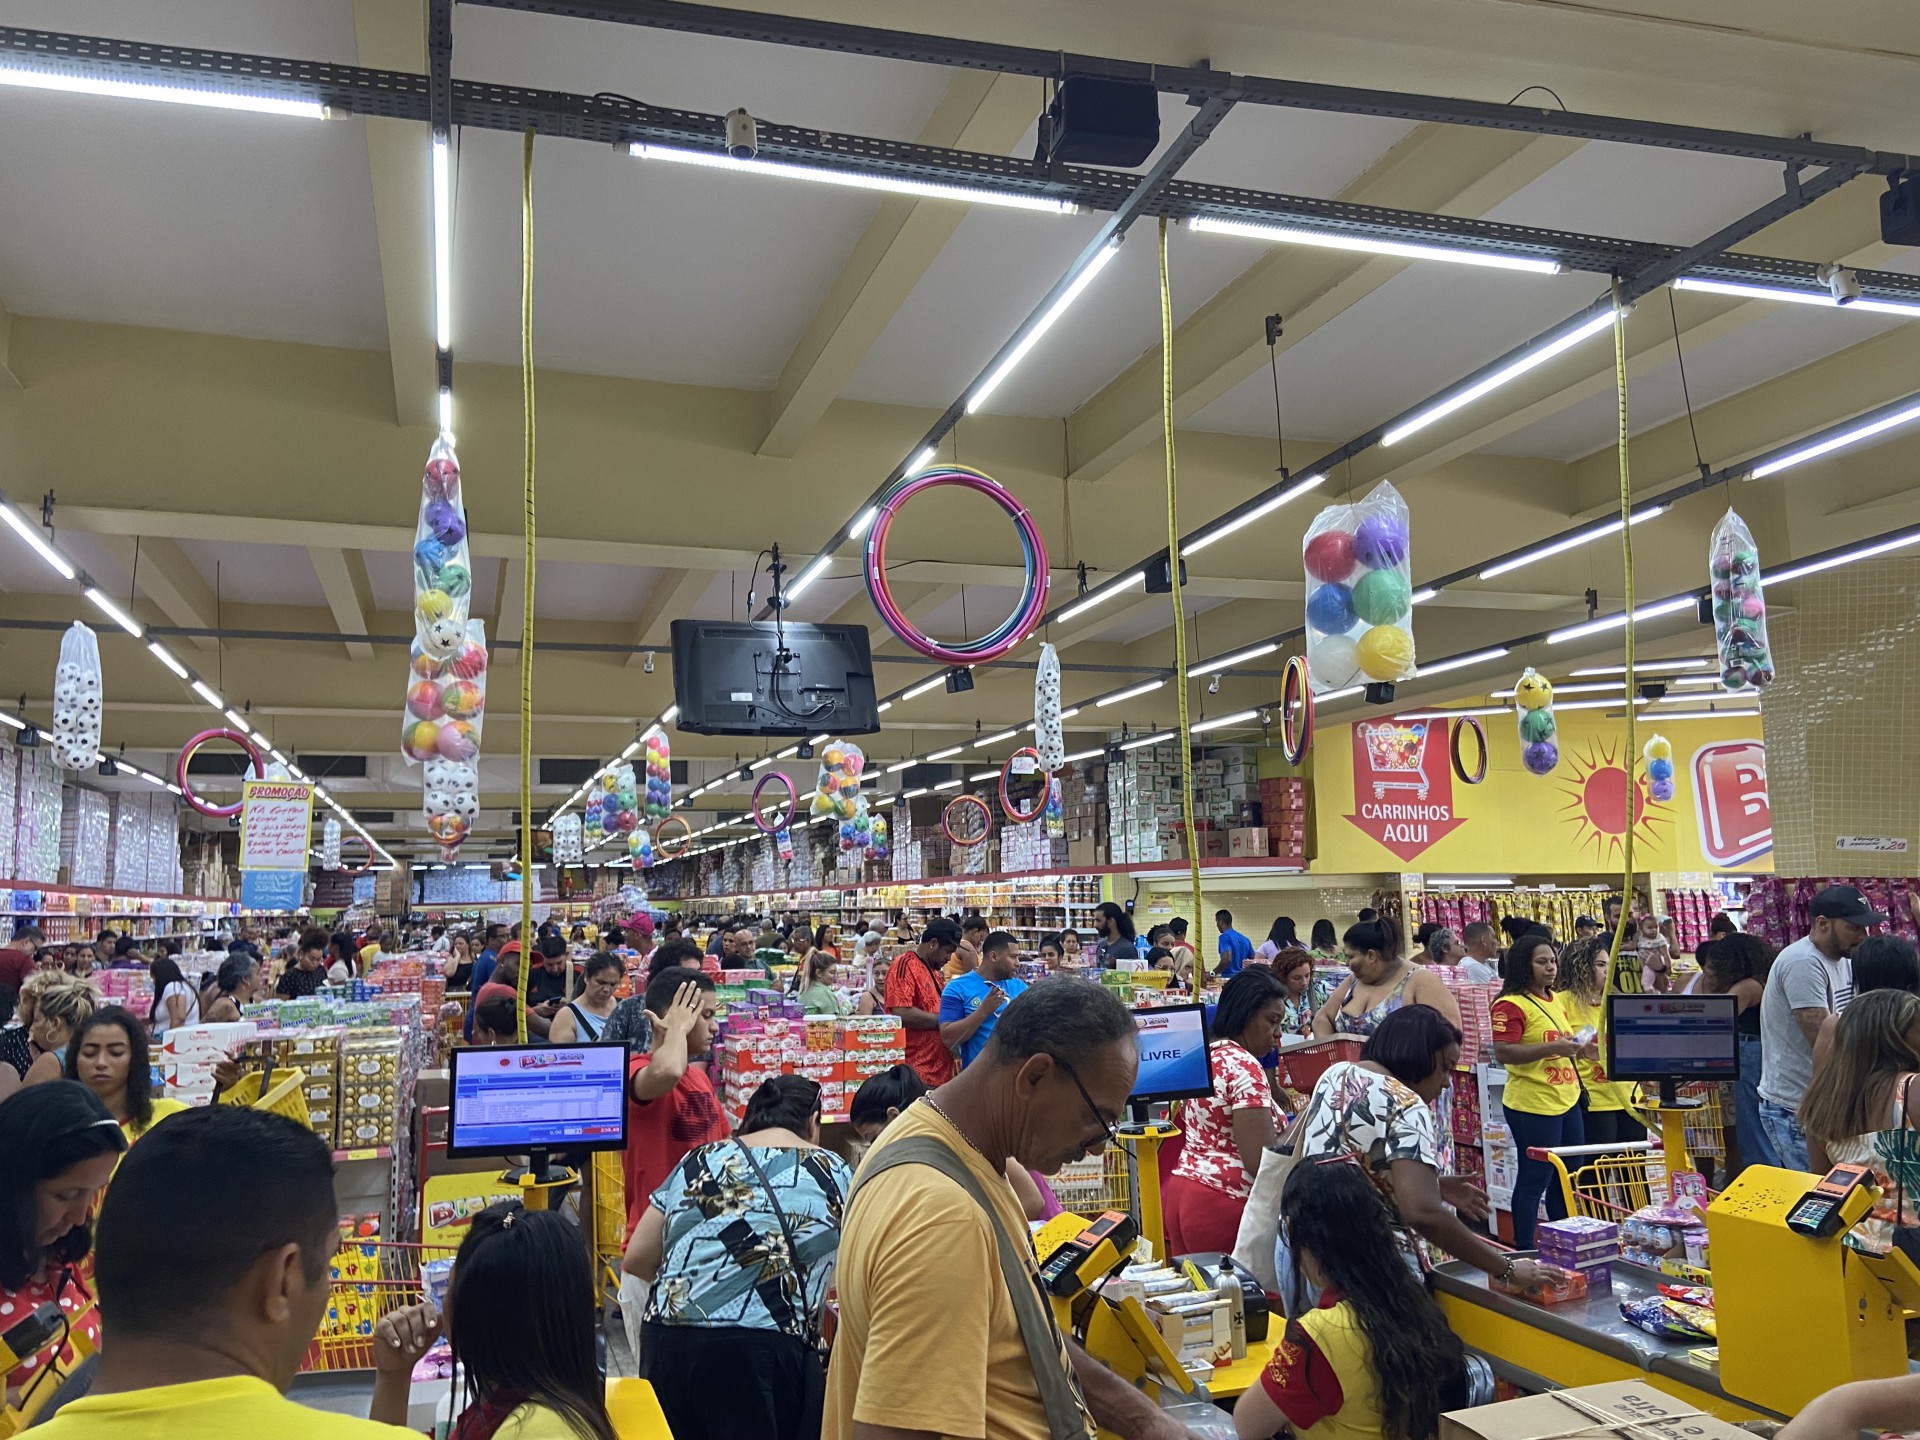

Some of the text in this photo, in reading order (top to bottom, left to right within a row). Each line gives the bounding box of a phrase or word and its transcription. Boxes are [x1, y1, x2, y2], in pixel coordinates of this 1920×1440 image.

[249, 785, 310, 801] PROMOÇÃO
[1361, 803, 1450, 821] CARRINHOS
[1382, 823, 1428, 843] AQUI
[247, 1004, 278, 1016] mentos
[282, 1016, 313, 1028] mentos
[336, 1013, 367, 1025] mentos
[1140, 1049, 1182, 1062] LIVRE
